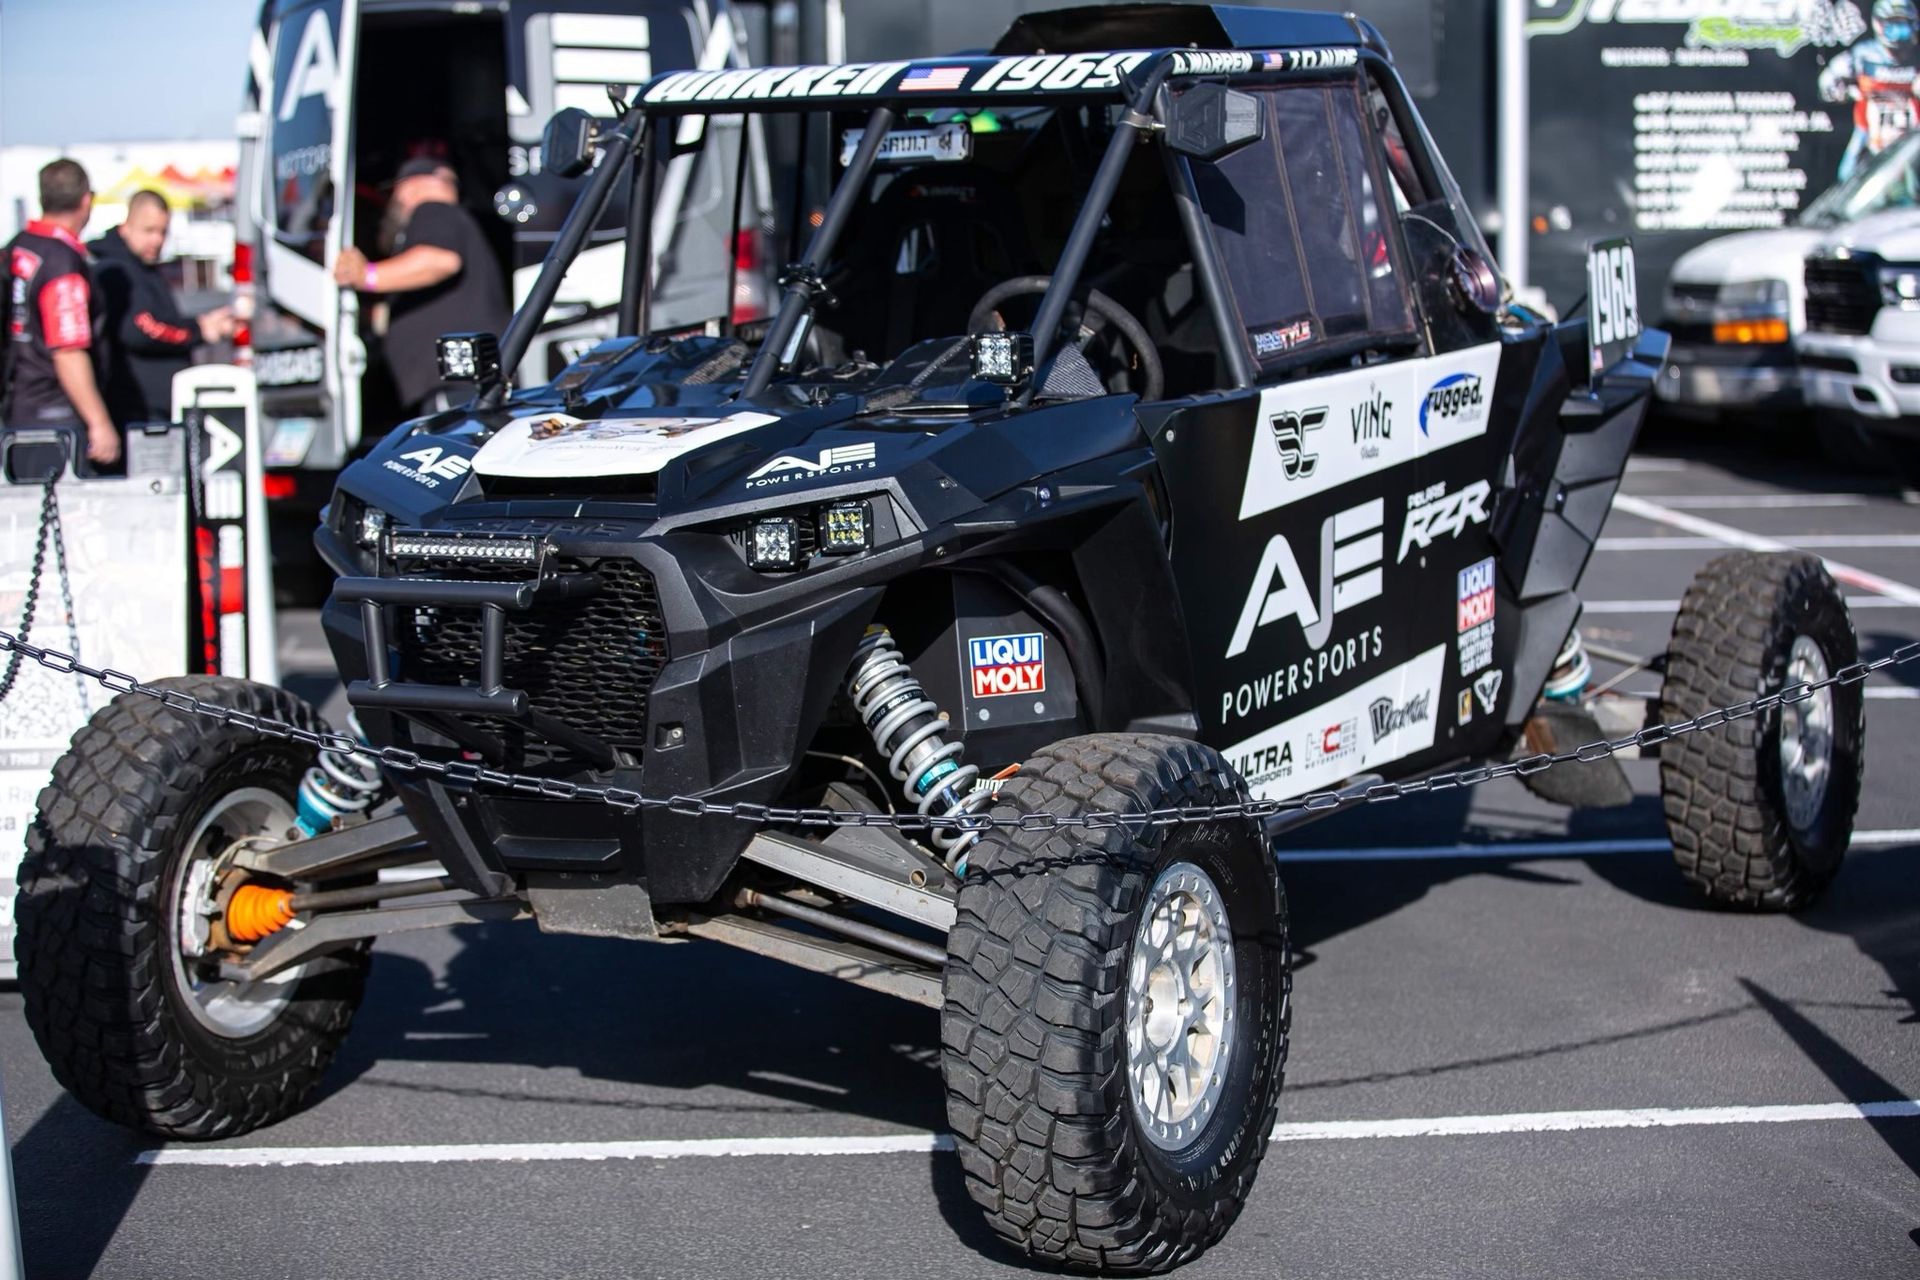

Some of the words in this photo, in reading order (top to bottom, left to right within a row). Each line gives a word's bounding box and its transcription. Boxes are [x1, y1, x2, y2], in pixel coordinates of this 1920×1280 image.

[643, 62, 911, 103] WARREN
[971, 52, 1151, 92] 1969
[1587, 246, 1639, 346] 1969
[1351, 391, 1392, 444] VING
[745, 461, 876, 489] POWERSPORTS
[1397, 479, 1491, 564] RZR
[1462, 563, 1493, 600] LIQUI
[1460, 590, 1493, 627] MOLY
[973, 636, 1039, 665] LIQUI
[976, 664, 1042, 694] MOLY
[1222, 625, 1383, 724] POWERSPORTS
